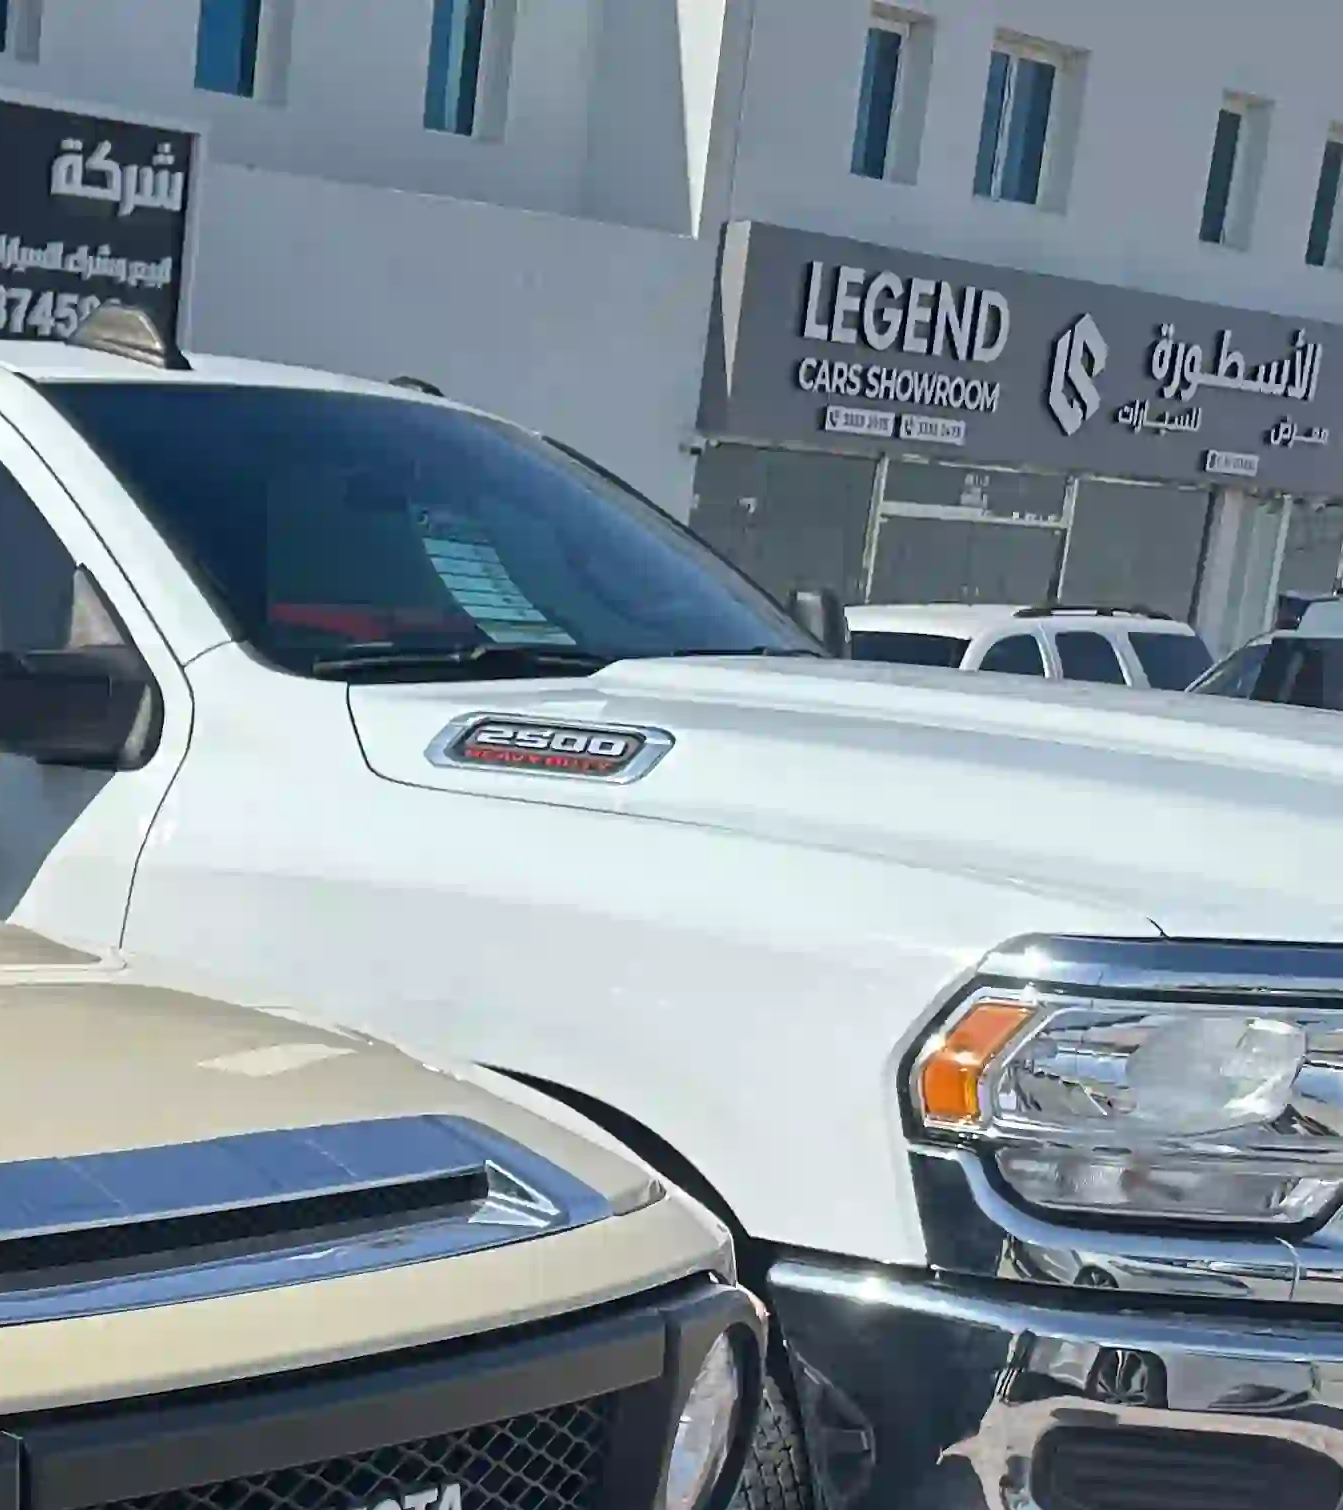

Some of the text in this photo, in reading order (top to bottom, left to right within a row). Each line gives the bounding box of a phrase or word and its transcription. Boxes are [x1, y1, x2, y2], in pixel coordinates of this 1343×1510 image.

[50, 137, 184, 216] شركة
[803, 260, 1011, 362] LEGEND
[798, 357, 1001, 413] CARS SHOWROOM
[1152, 323, 1322, 402] الأسطورة
[1270, 414, 1330, 449] معرض
[476, 727, 627, 757] 2500
